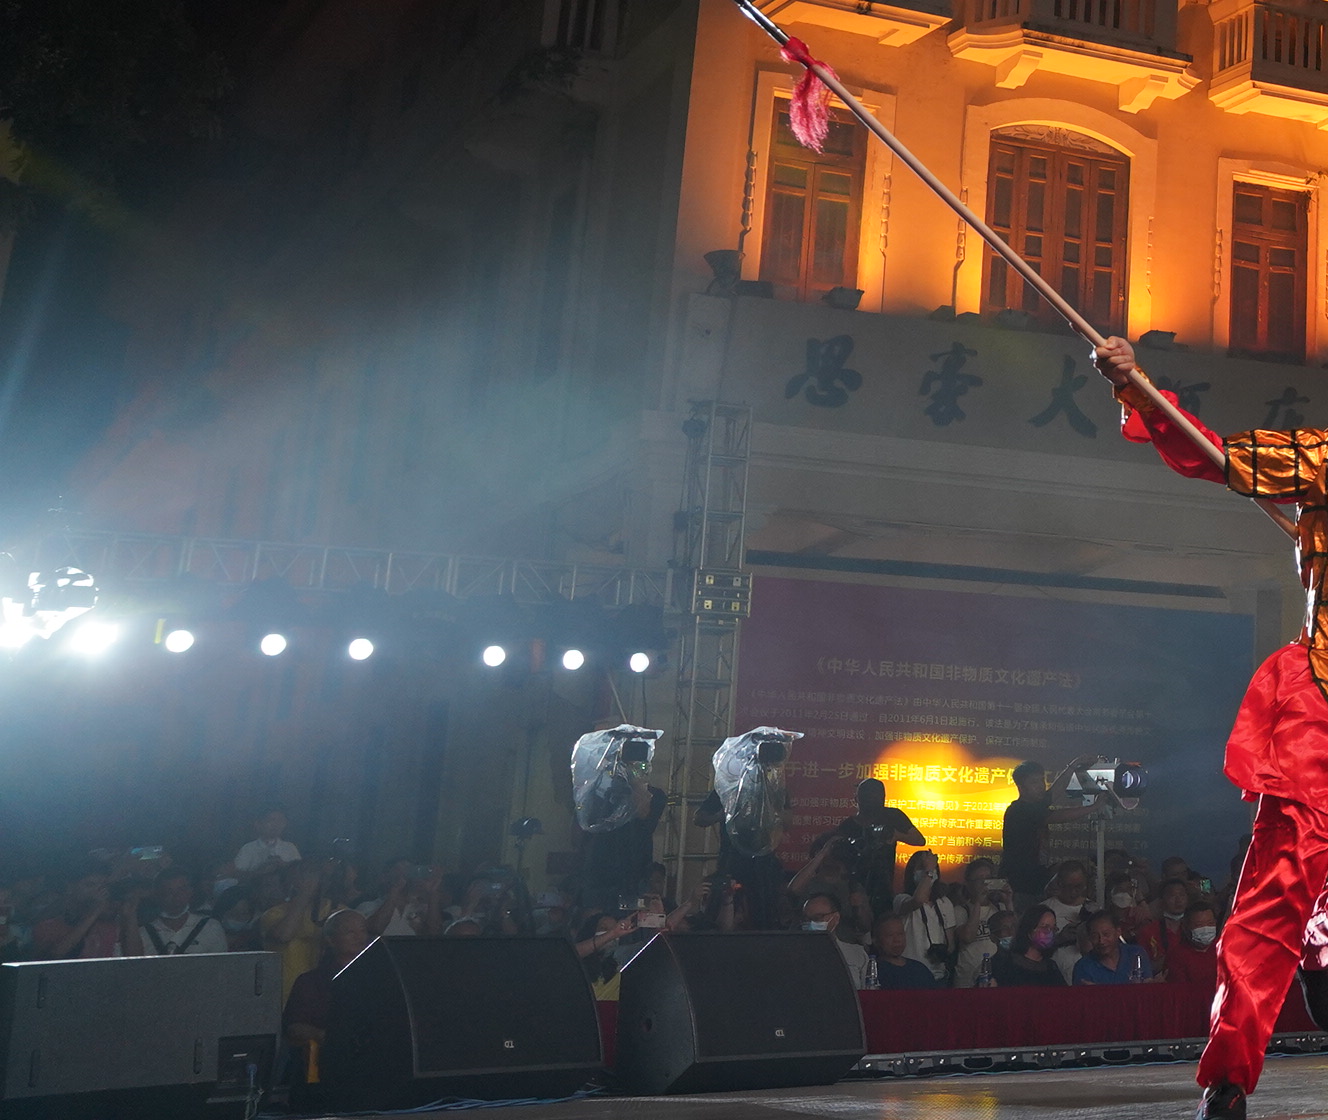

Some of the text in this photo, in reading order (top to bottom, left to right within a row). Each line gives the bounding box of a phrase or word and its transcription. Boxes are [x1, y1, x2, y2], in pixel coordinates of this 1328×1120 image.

[925, 836, 1004, 847] 述了当前和今后一
